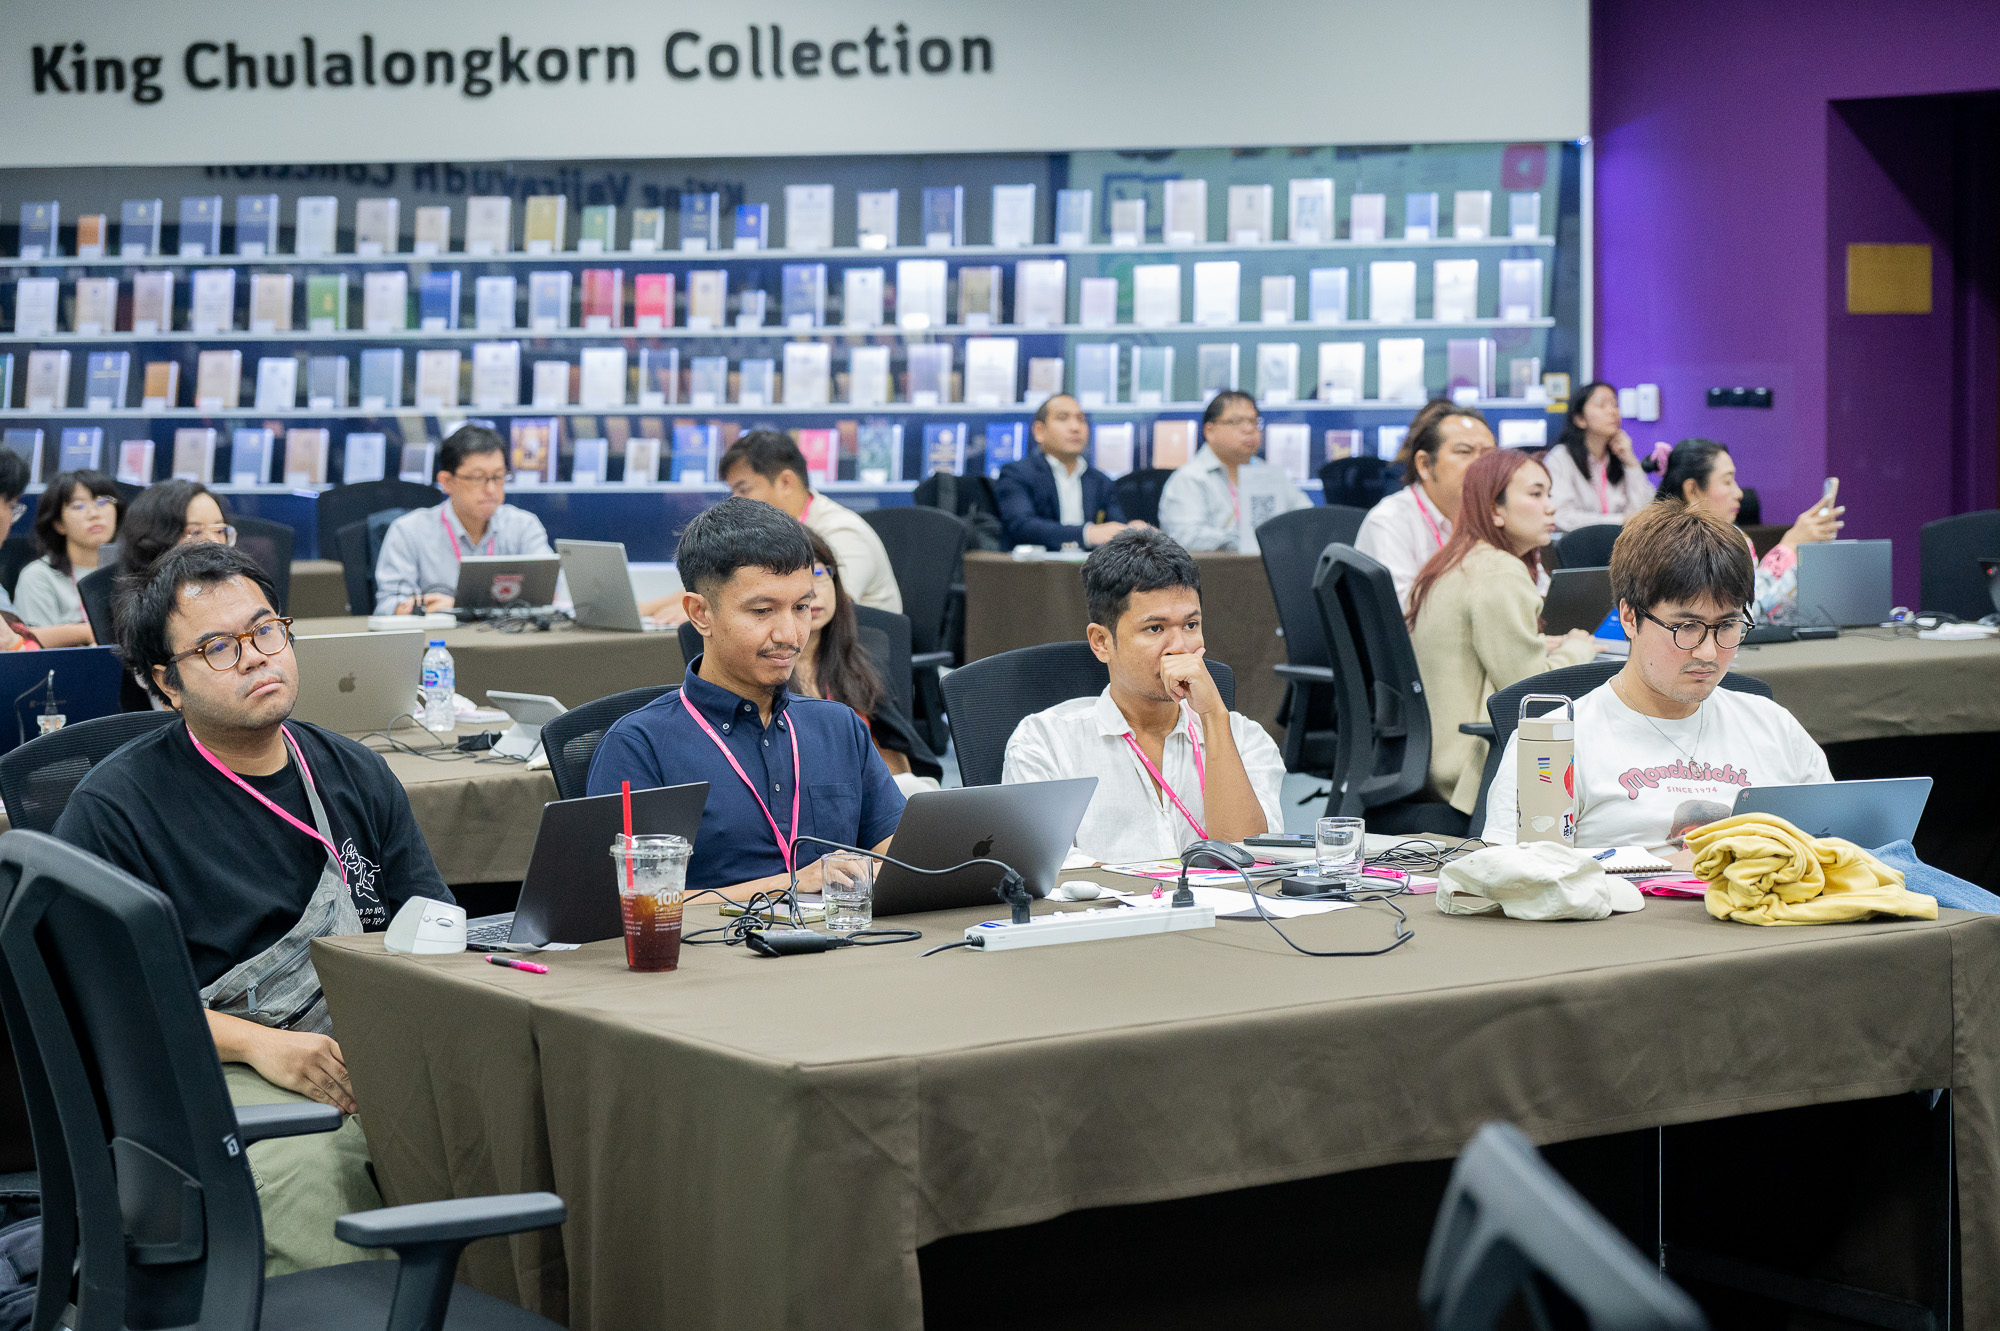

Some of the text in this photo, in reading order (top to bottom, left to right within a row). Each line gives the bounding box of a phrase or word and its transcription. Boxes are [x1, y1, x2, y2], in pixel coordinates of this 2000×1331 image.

[30, 23, 992, 105] King Chulalongkorn Collection
[1666, 786, 1718, 794] SINCE 1974
